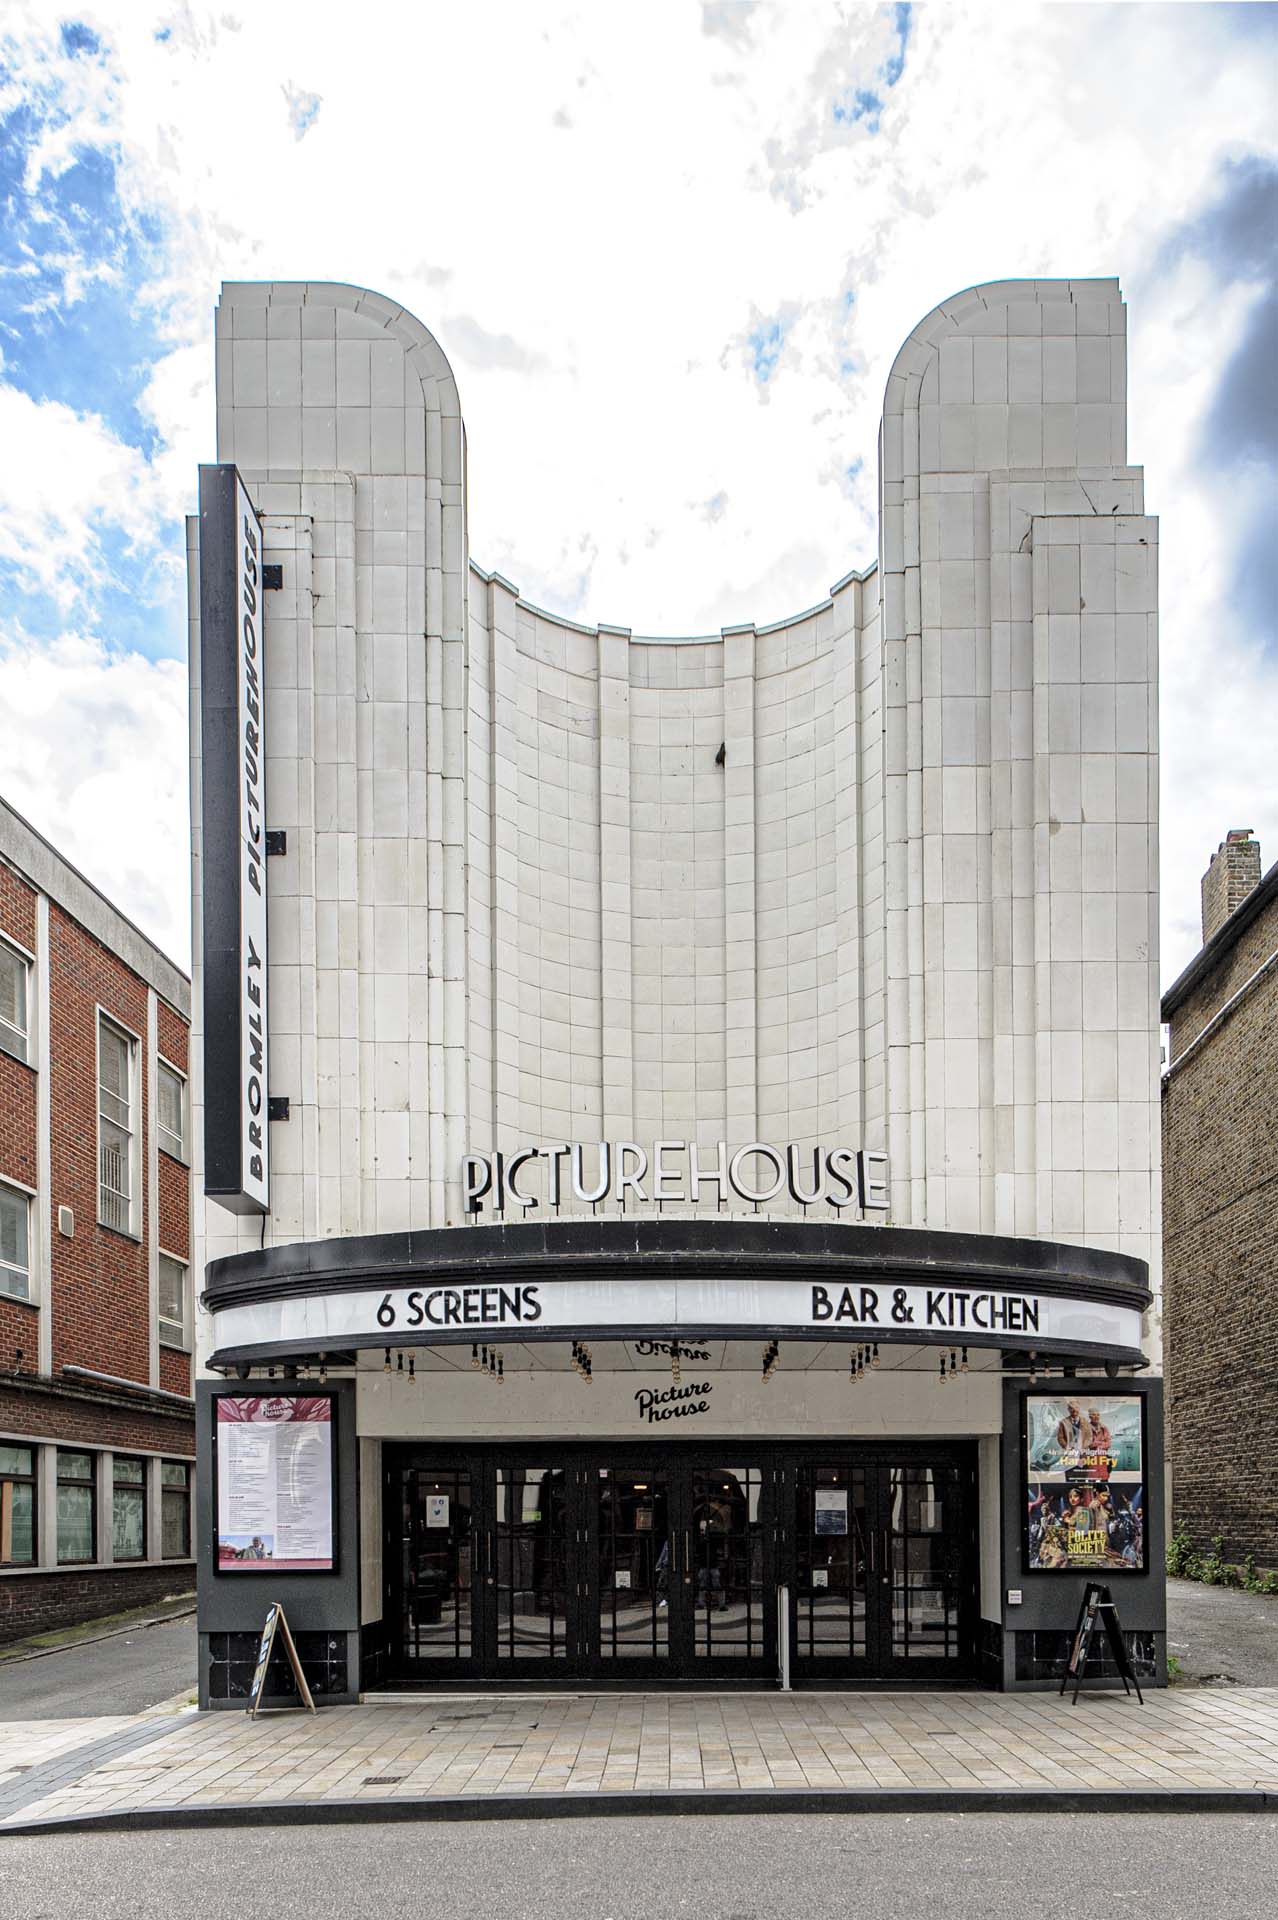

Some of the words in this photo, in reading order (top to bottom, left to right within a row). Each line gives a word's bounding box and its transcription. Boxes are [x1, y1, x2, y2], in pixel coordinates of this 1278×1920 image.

[244, 514, 261, 896] PICTUREHOUSE
[248, 935, 263, 1182] BROMLEY
[462, 1140, 890, 1213] PICTUREHOUSE
[377, 1293, 395, 1328] 6
[407, 1285, 542, 1326] SCREENS
[812, 1286, 879, 1322] BAR
[891, 1288, 914, 1323] &
[926, 1290, 1039, 1332] KITCHEN
[634, 1381, 713, 1418] Picture
[648, 1400, 710, 1423] house
[1060, 1456, 1097, 1466] Harold
[1099, 1456, 1118, 1467] Fry
[1068, 1530, 1106, 1543] POLITE
[1068, 1540, 1106, 1554] SOCIETY
